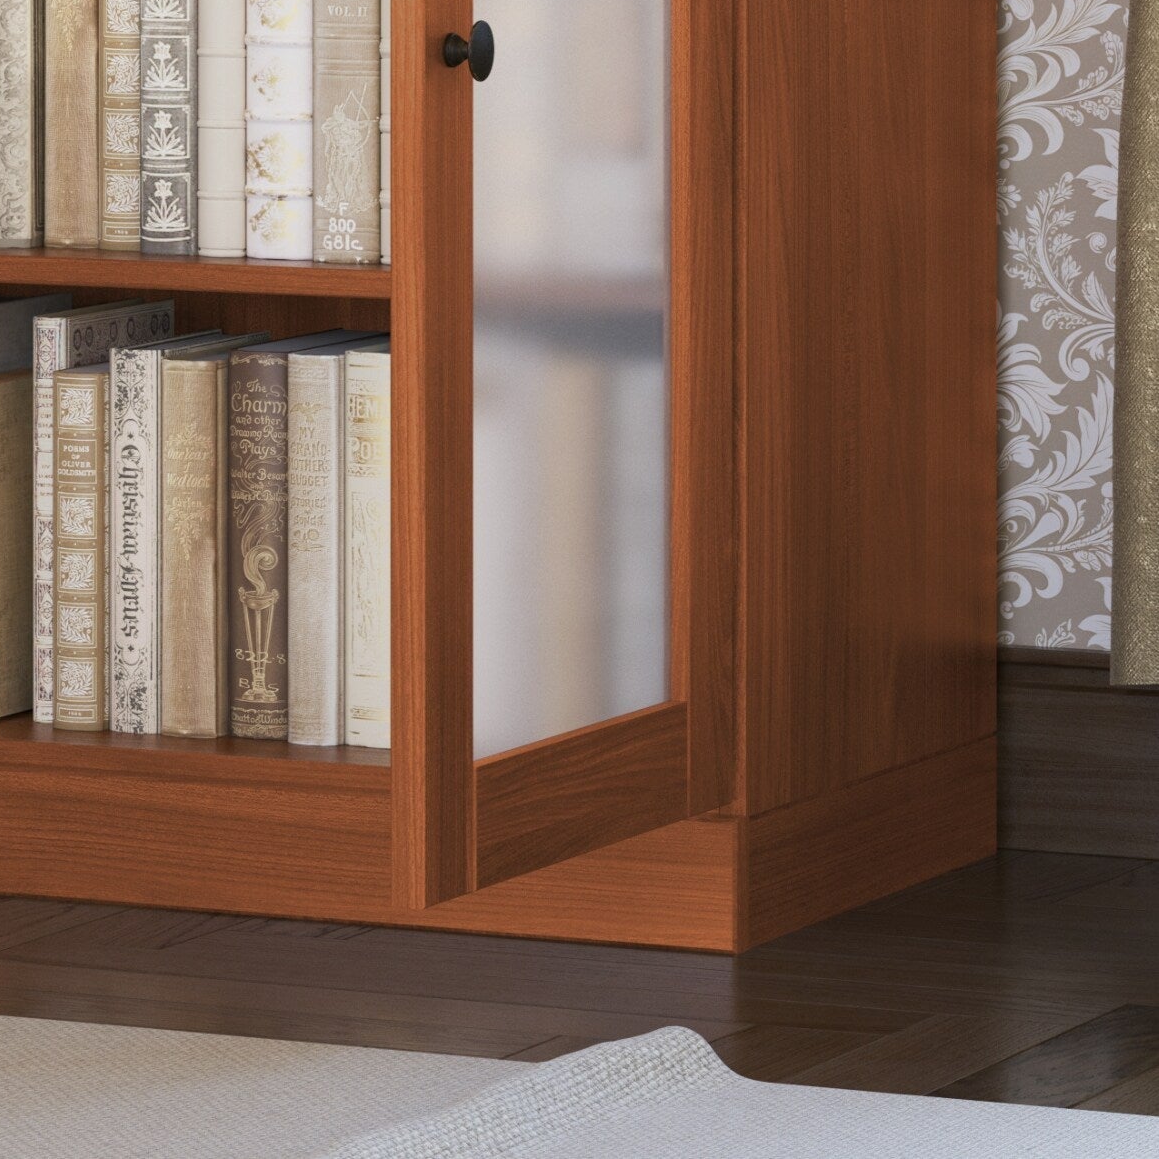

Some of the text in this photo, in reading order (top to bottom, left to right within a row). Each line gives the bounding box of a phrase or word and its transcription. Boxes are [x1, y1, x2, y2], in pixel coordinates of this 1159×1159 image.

[339, 202, 349, 216] F
[329, 217, 357, 234] 800
[246, 379, 267, 393] The
[231, 393, 287, 416] Charm
[235, 414, 281, 426] and other
[299, 426, 315, 440] MY
[63, 445, 90, 453] POEMS
[240, 439, 277, 459] Plays
[61, 460, 91, 468] OLIVER
[290, 473, 329, 487] BUDGET
